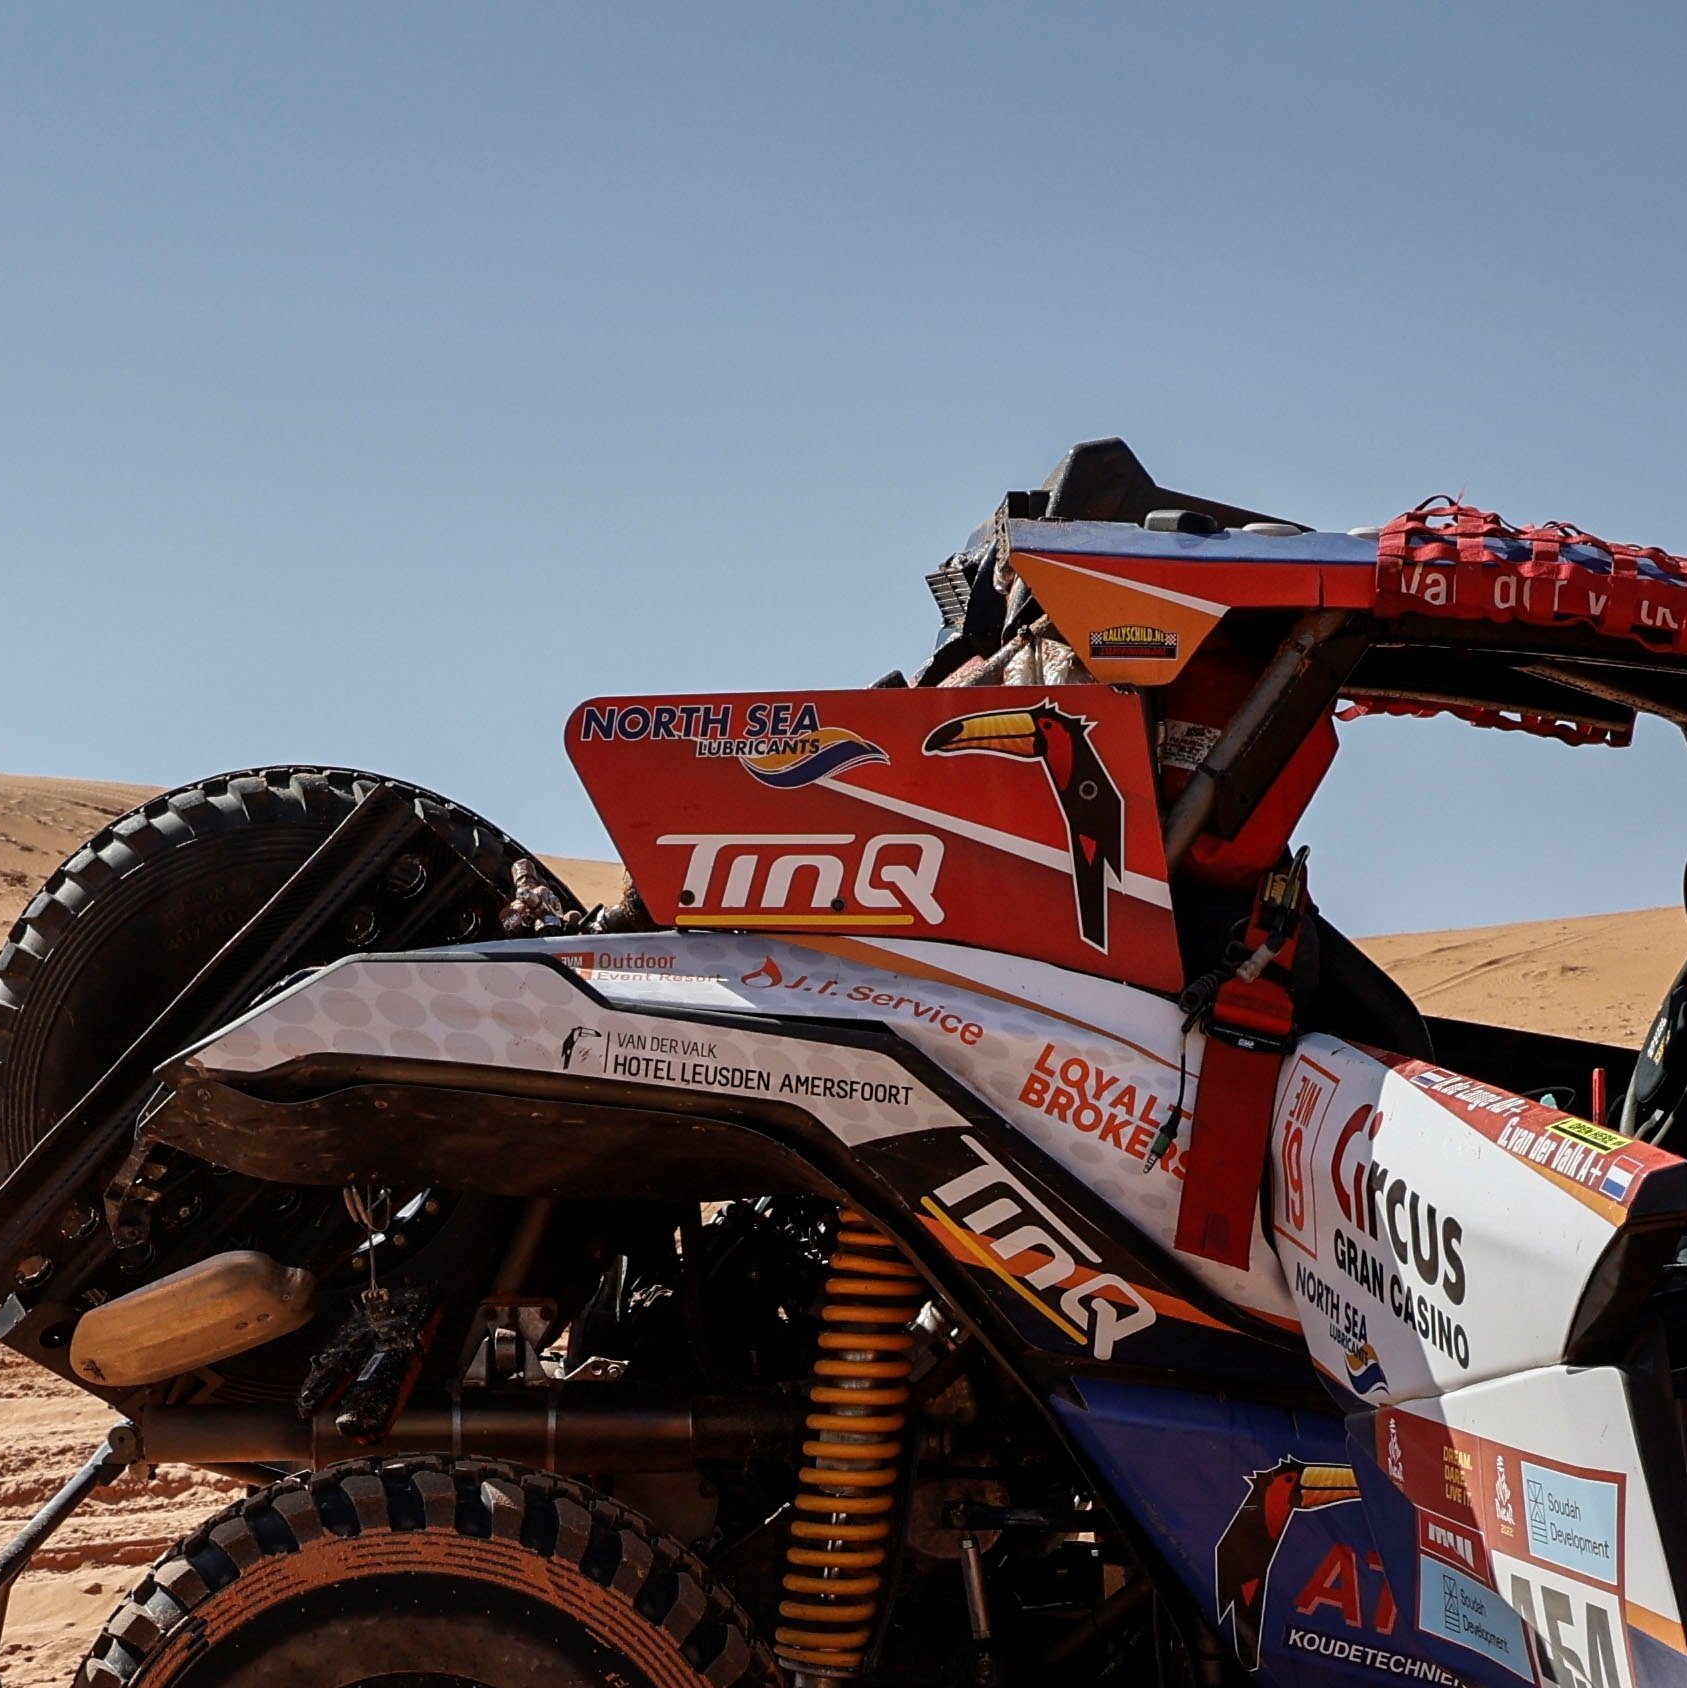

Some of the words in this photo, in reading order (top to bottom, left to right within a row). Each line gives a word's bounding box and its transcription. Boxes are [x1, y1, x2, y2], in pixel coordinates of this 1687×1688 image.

[580, 705, 732, 742] NORTH
[744, 702, 822, 738] SEA
[696, 737, 821, 758] LUBRICANTS
[597, 971, 654, 982] Event
[598, 953, 677, 970] Outdoor
[847, 985, 984, 1046] Service
[617, 1031, 648, 1051] VAN
[650, 1036, 680, 1054] DER
[681, 1038, 718, 1059] VALK
[613, 1055, 676, 1081] HOTEL
[680, 1062, 771, 1091] LEUSDEN
[779, 1073, 914, 1105] AMERSFOORT
[1568, 1121, 1591, 1138] OPEN
[1532, 1130, 1555, 1163] der
[1551, 1137, 1588, 1181] Valk
[1330, 1103, 1466, 1305] Circus
[1296, 1262, 1341, 1323] NORTH
[1344, 1302, 1368, 1344] SEA
[1333, 1228, 1385, 1304] GRAN
[1390, 1274, 1470, 1370] CASINO
[1445, 1483, 1463, 1504] LIVE
[1547, 1492, 1581, 1521] Soudah
[1550, 1522, 1610, 1560] Development
[1461, 1588, 1487, 1617] Soudah
[1462, 1616, 1510, 1655] Development
